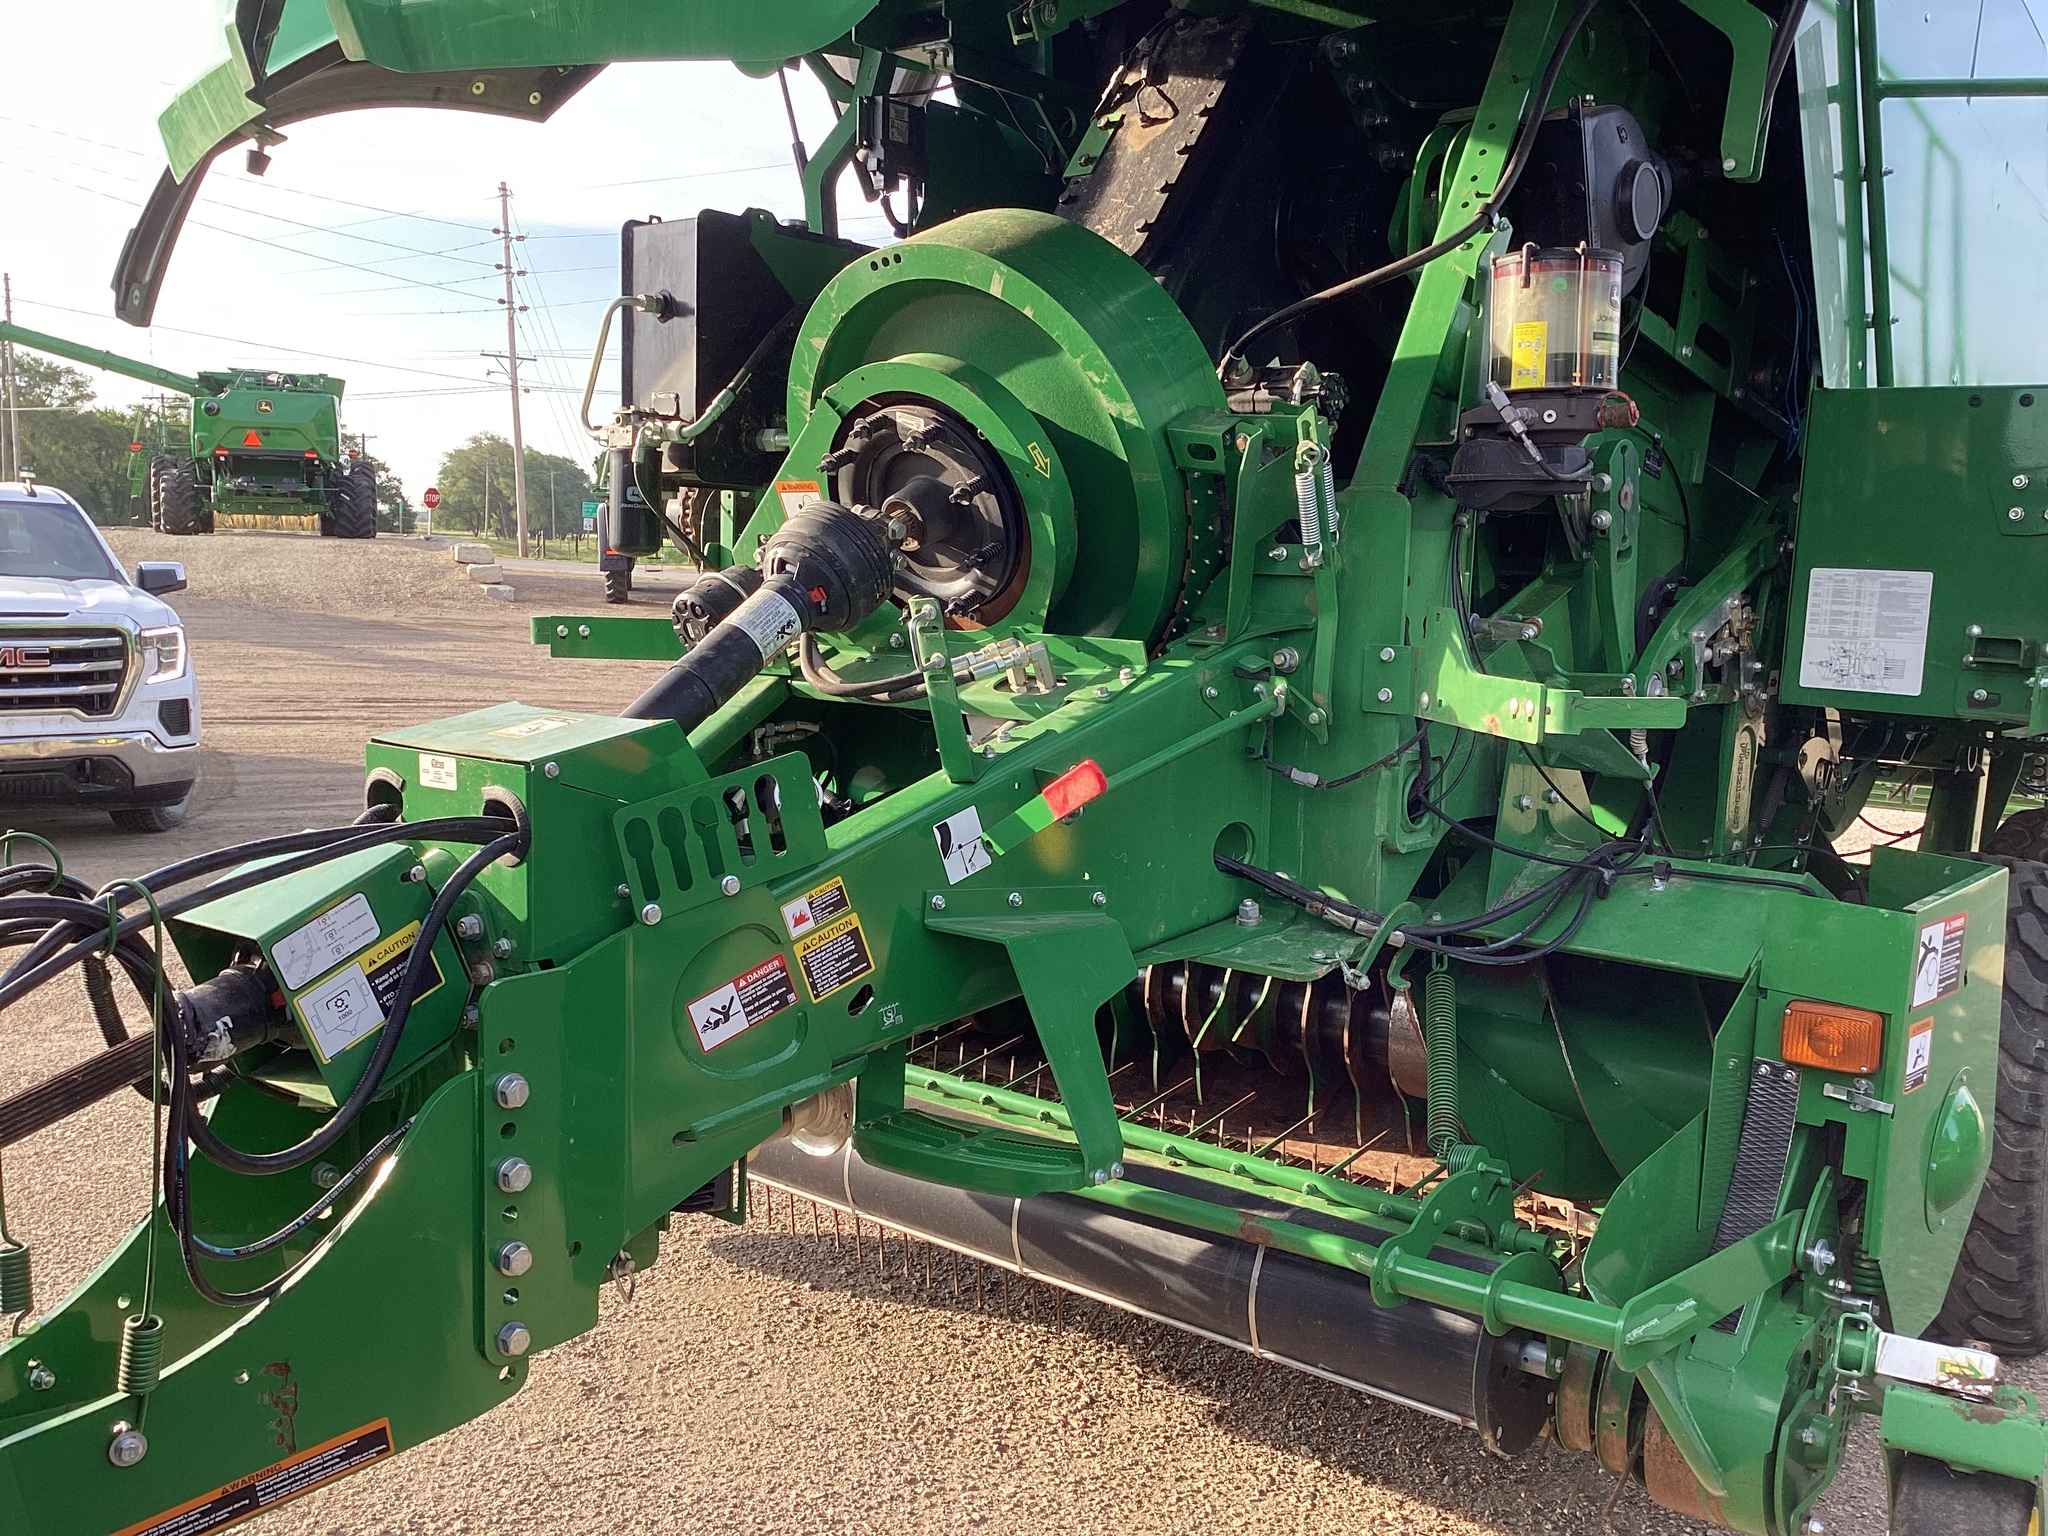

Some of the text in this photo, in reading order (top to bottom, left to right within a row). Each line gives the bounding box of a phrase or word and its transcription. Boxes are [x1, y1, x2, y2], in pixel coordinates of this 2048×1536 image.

[424, 494, 439, 503] STOP
[814, 880, 840, 896] CAUTION
[810, 919, 853, 947] CAUTION
[376, 932, 416, 960] CAUTION
[375, 973, 390, 985] Keep
[388, 967, 396, 975] all
[746, 960, 780, 982] DANGER
[377, 978, 394, 991] guard
[382, 991, 395, 1001] PTO
[339, 1009, 353, 1021] 1000
[354, 1165, 364, 1175] SAE
[230, 1464, 283, 1490] WARNING
